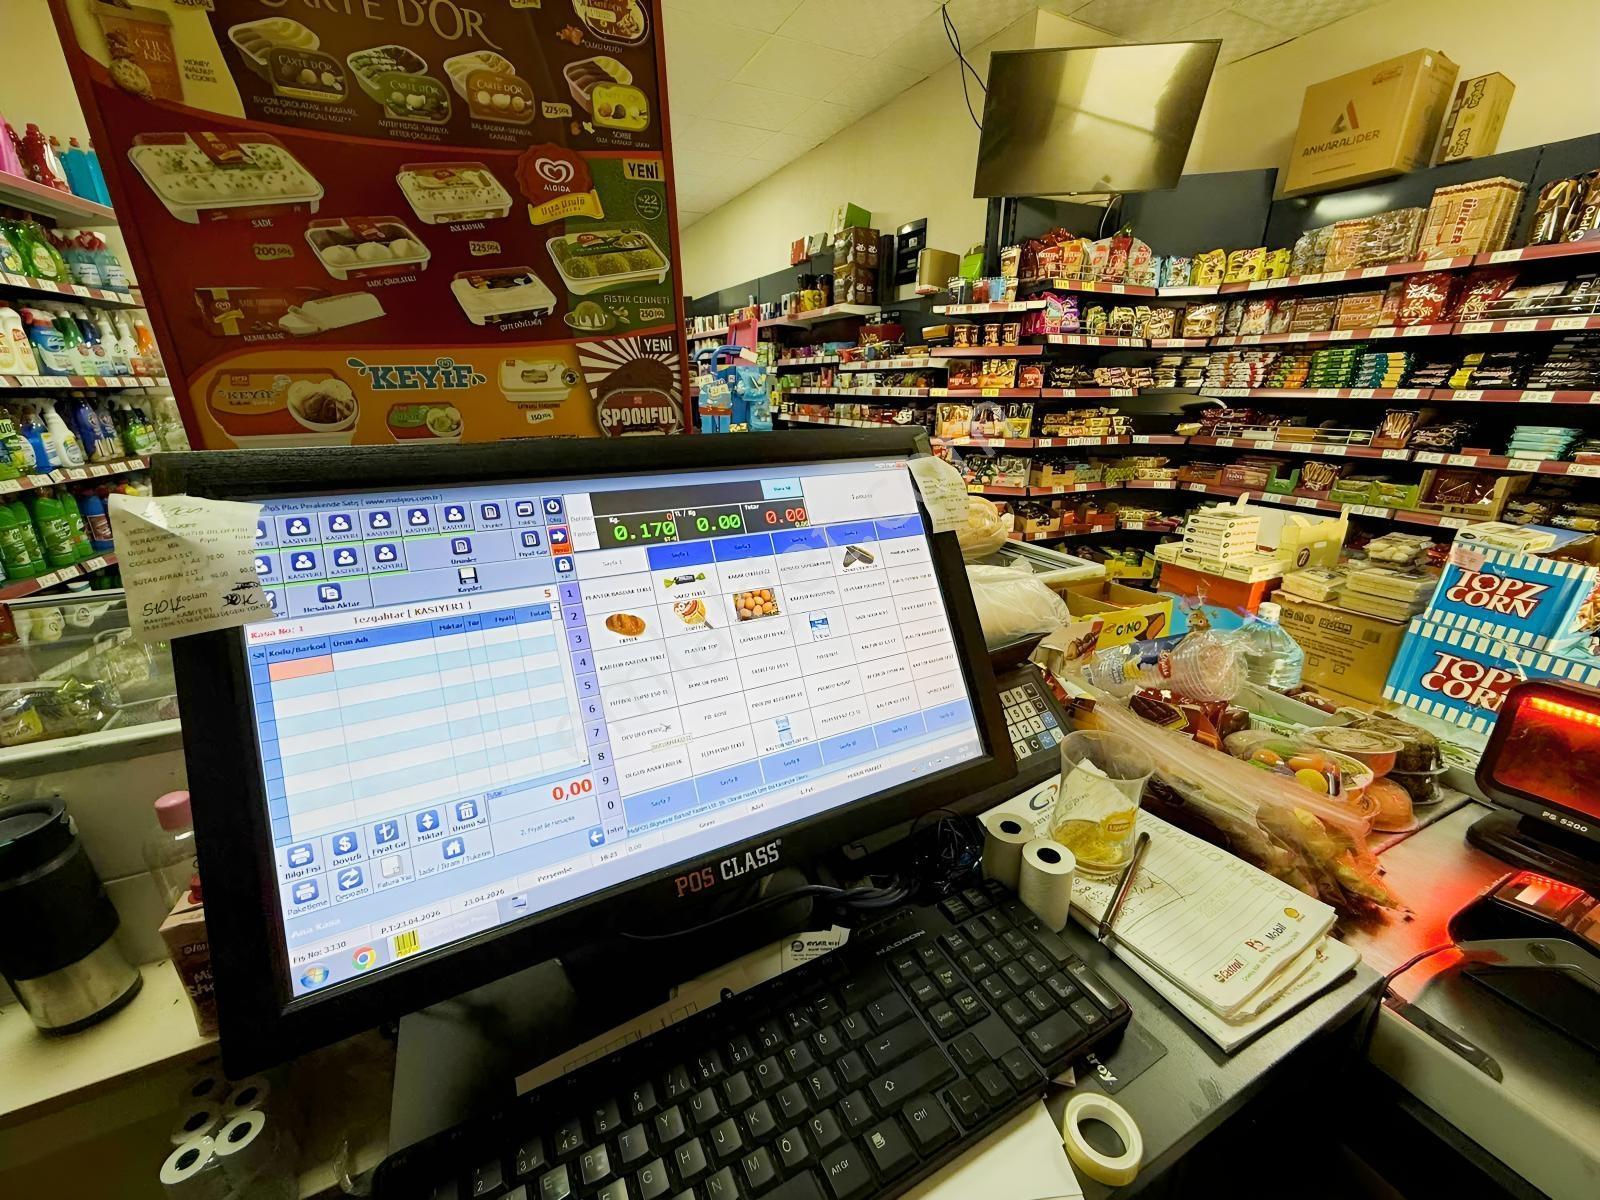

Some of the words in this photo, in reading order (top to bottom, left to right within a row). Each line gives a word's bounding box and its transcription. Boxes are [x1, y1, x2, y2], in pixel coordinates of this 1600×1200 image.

[629, 161, 660, 180] YENİ
[543, 184, 571, 193] ALGIDA
[643, 336, 673, 352] YENİ
[601, 406, 676, 428] SPOONFUL
[613, 520, 677, 541] 0.170
[696, 514, 742, 533] 0.00
[765, 507, 807, 525] 0.00
[1455, 567, 1551, 603] TOPZ
[544, 589, 552, 599] 5
[566, 589, 574, 599] 1
[1445, 586, 1540, 620] CORN
[571, 612, 579, 621] 2
[575, 635, 583, 644] 3
[579, 658, 587, 668] 4
[584, 681, 592, 690] 5
[588, 704, 596, 714] 6
[593, 728, 600, 738] 7
[597, 752, 605, 761] 8
[602, 776, 610, 786] 9
[552, 778, 594, 802] 0,00
[606, 800, 615, 810] 0
[674, 866, 716, 899] POS
[719, 841, 780, 882] CLASS
[1264, 921, 1288, 941] Mobil
